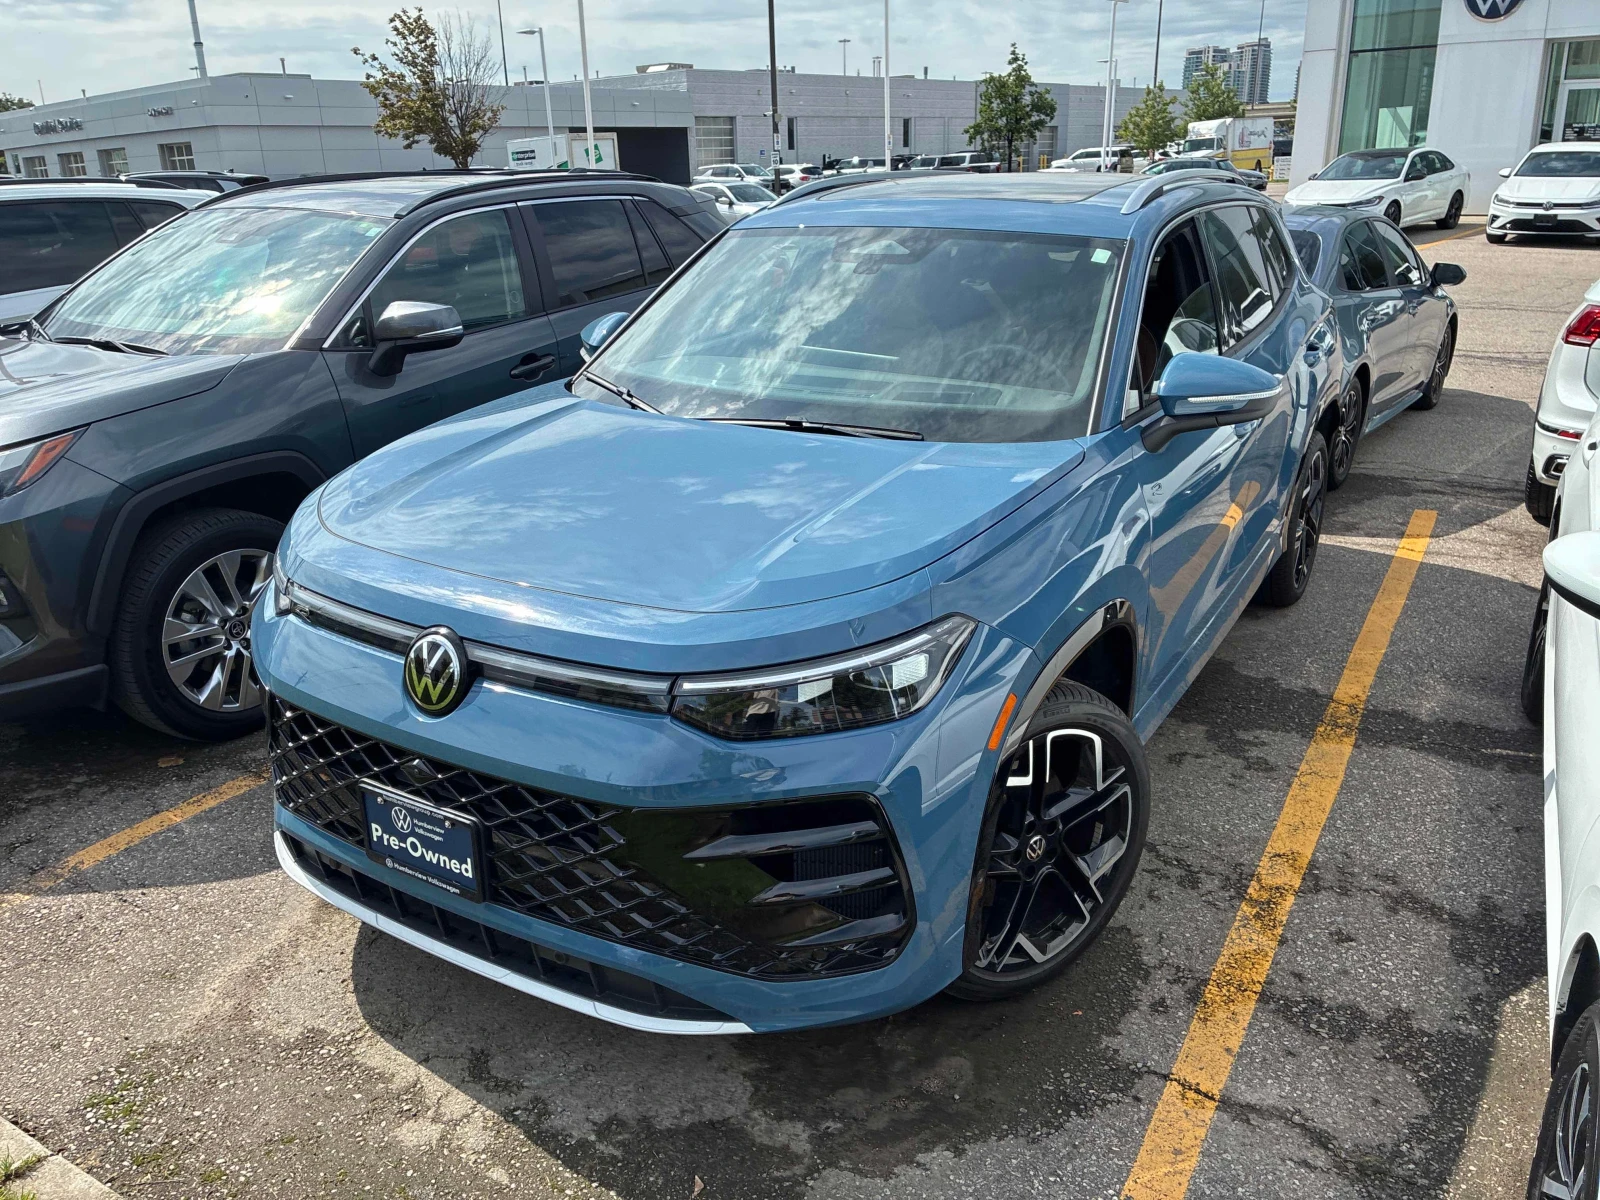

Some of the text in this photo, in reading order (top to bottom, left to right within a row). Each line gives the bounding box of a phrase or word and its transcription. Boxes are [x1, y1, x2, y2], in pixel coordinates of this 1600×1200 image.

[413, 818, 444, 834] Humberview
[414, 826, 444, 842] Volkswagen
[370, 822, 473, 878] Pre-Owned
[394, 862, 460, 894] Humberview Volkswagen
